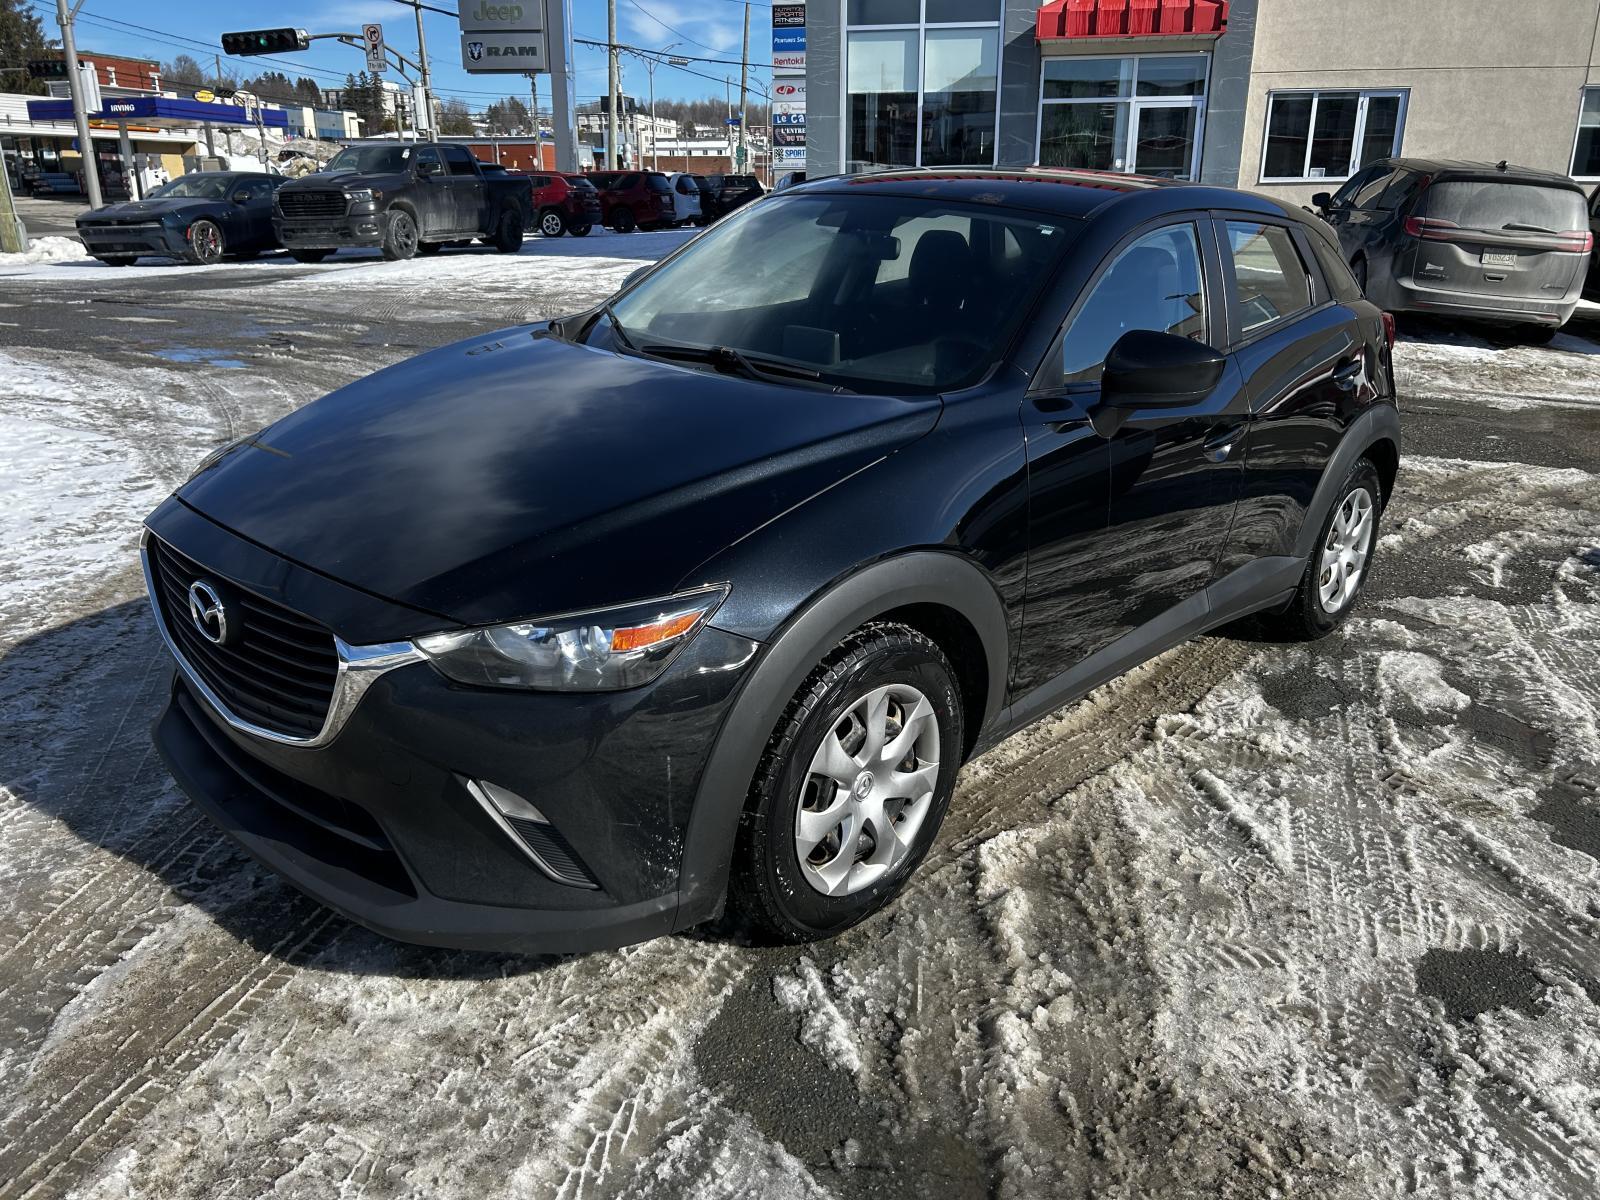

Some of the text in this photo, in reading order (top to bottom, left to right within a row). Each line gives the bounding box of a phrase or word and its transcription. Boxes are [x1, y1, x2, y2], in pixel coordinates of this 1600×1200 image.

[473, 1, 523, 24] Jeep
[486, 46, 538, 57] RAM
[110, 104, 135, 112] IRVING
[791, 114, 804, 123] Ca
